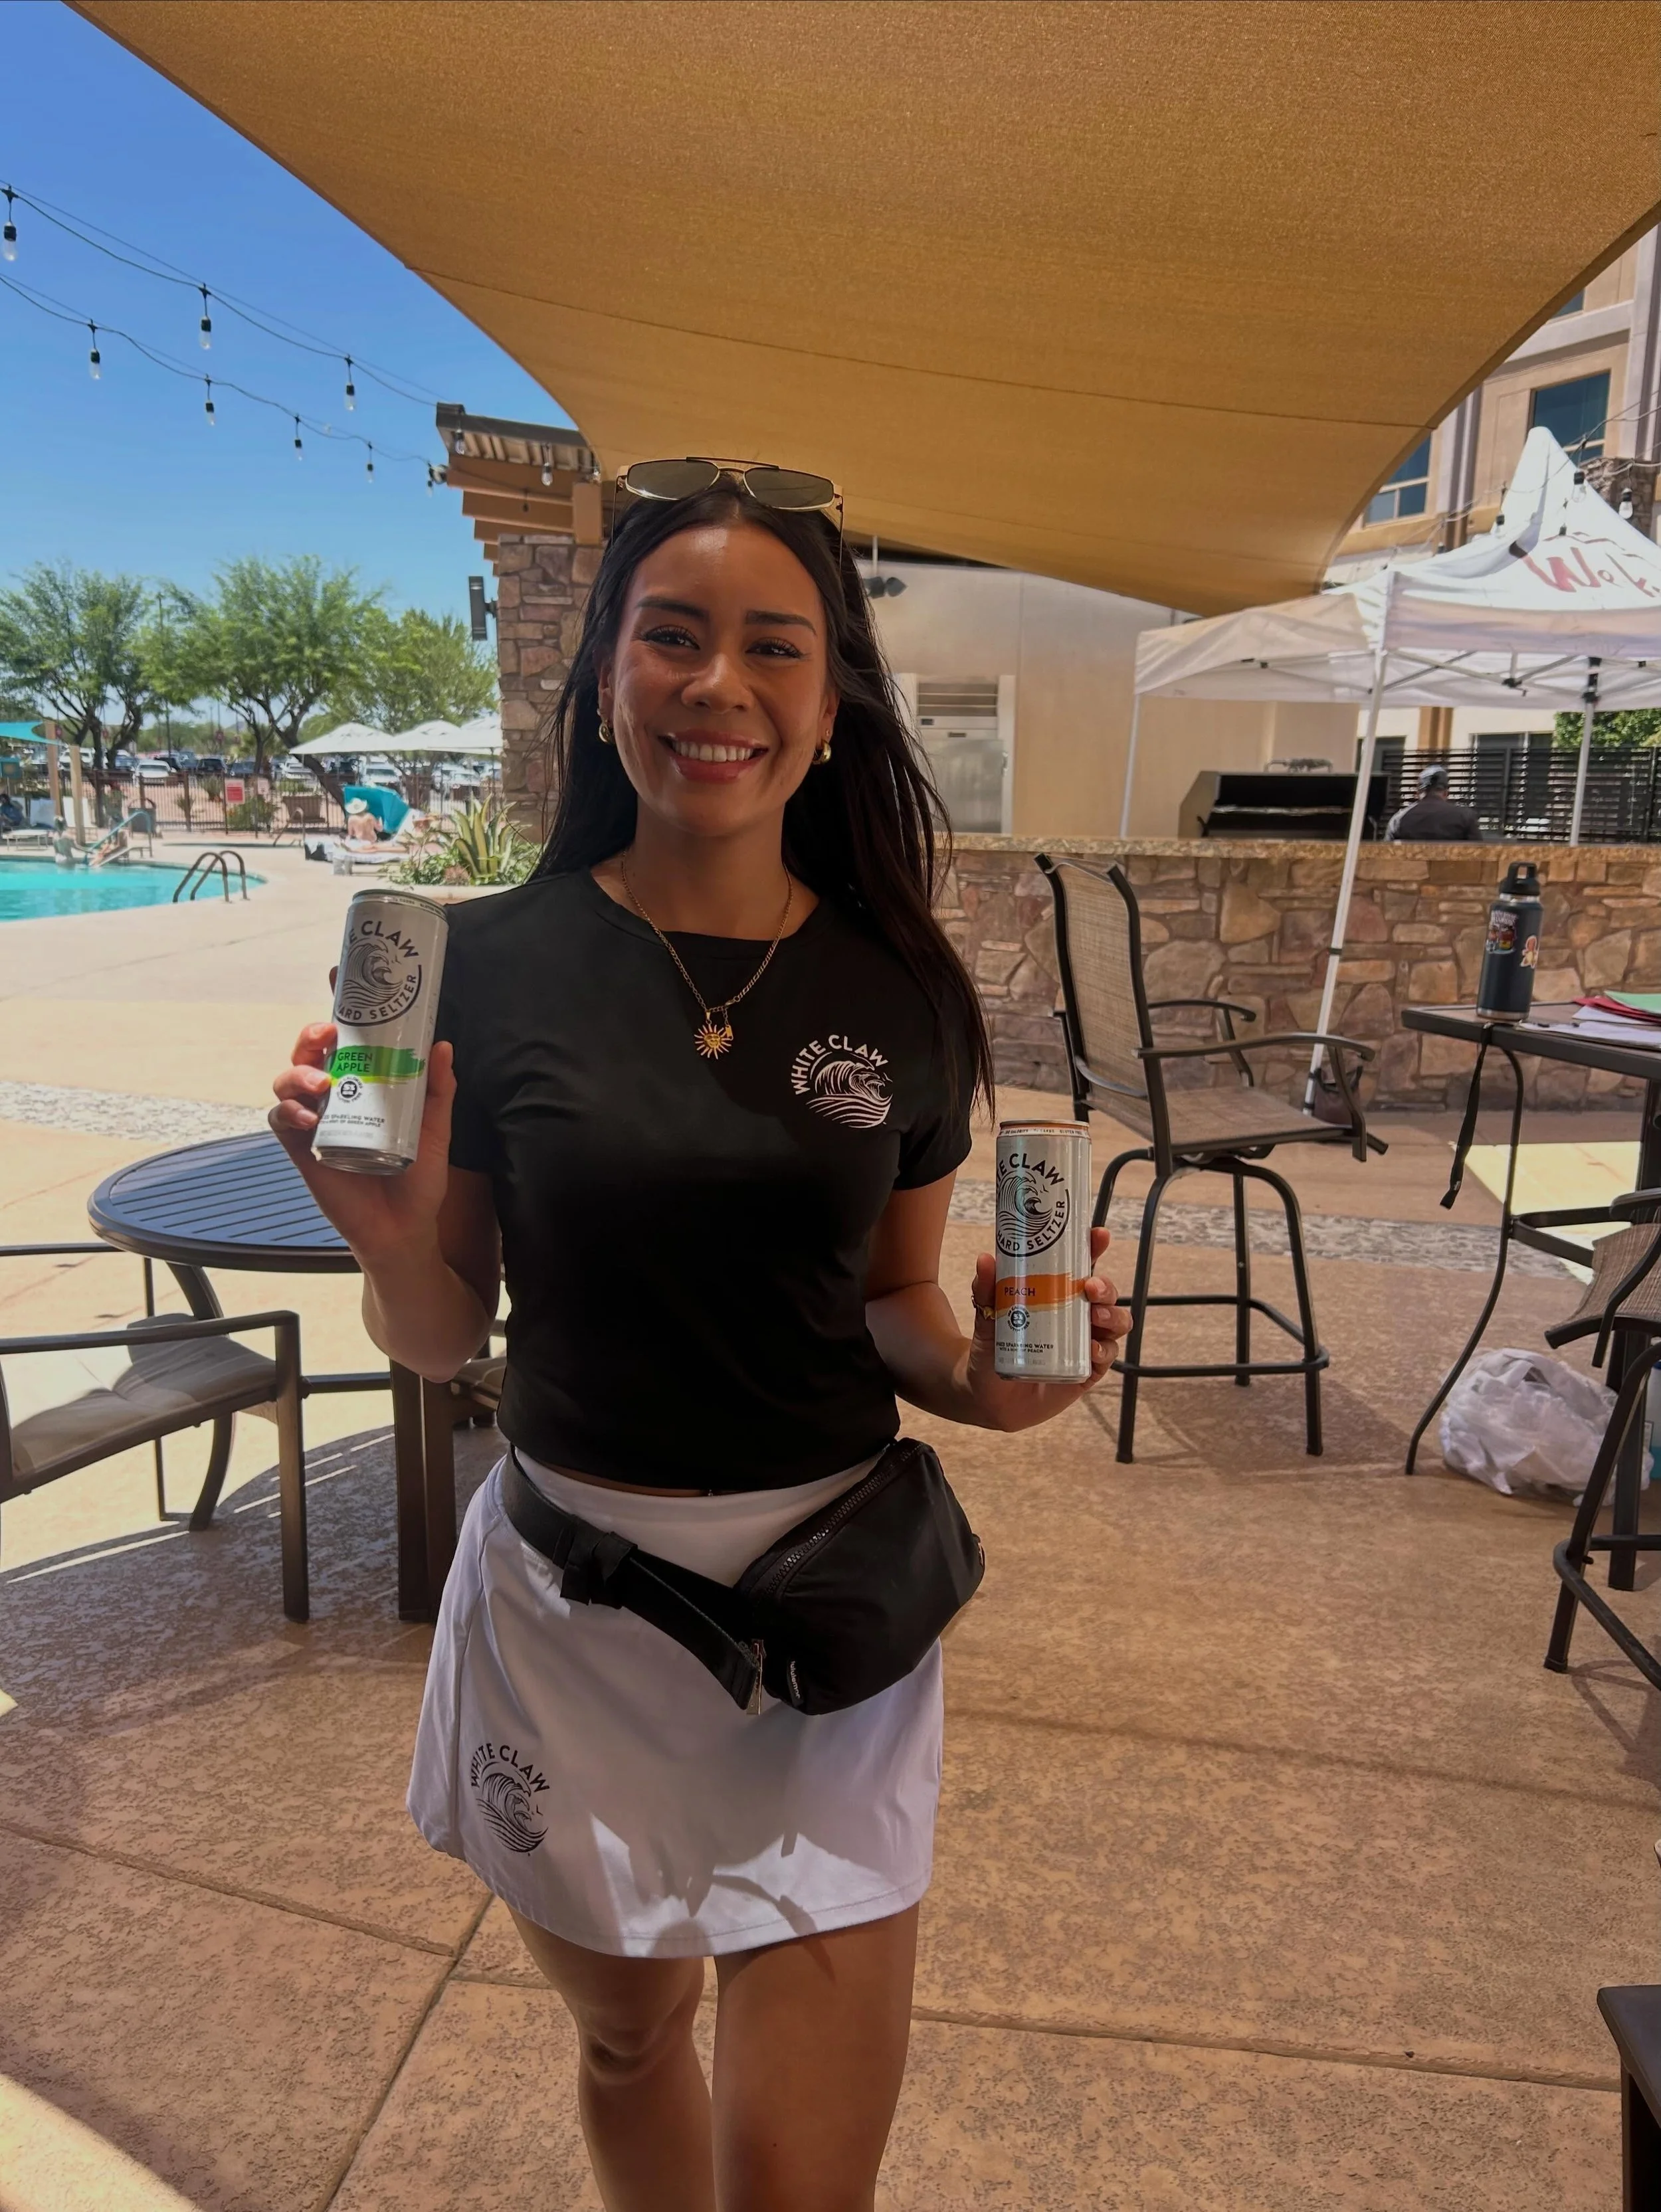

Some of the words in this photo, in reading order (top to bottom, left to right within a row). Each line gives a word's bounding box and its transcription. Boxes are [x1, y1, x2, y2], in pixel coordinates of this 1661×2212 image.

[361, 921, 419, 958] CLAW
[369, 974, 417, 1020] SELTZER
[336, 1062, 370, 1073] APPLE
[338, 1052, 373, 1061] GREEN
[791, 1040, 827, 1095] WHITE
[828, 1034, 889, 1067] CLAW
[1009, 1153, 1064, 1186] CLAW
[997, 1230, 1021, 1251] HARD
[1026, 1200, 1066, 1250] SELTZER
[1004, 1287, 1036, 1296] PEACH
[790, 1661, 801, 1699] lululemon
[470, 1743, 496, 1788] WHITE
[500, 1745, 550, 1793] CLAW
